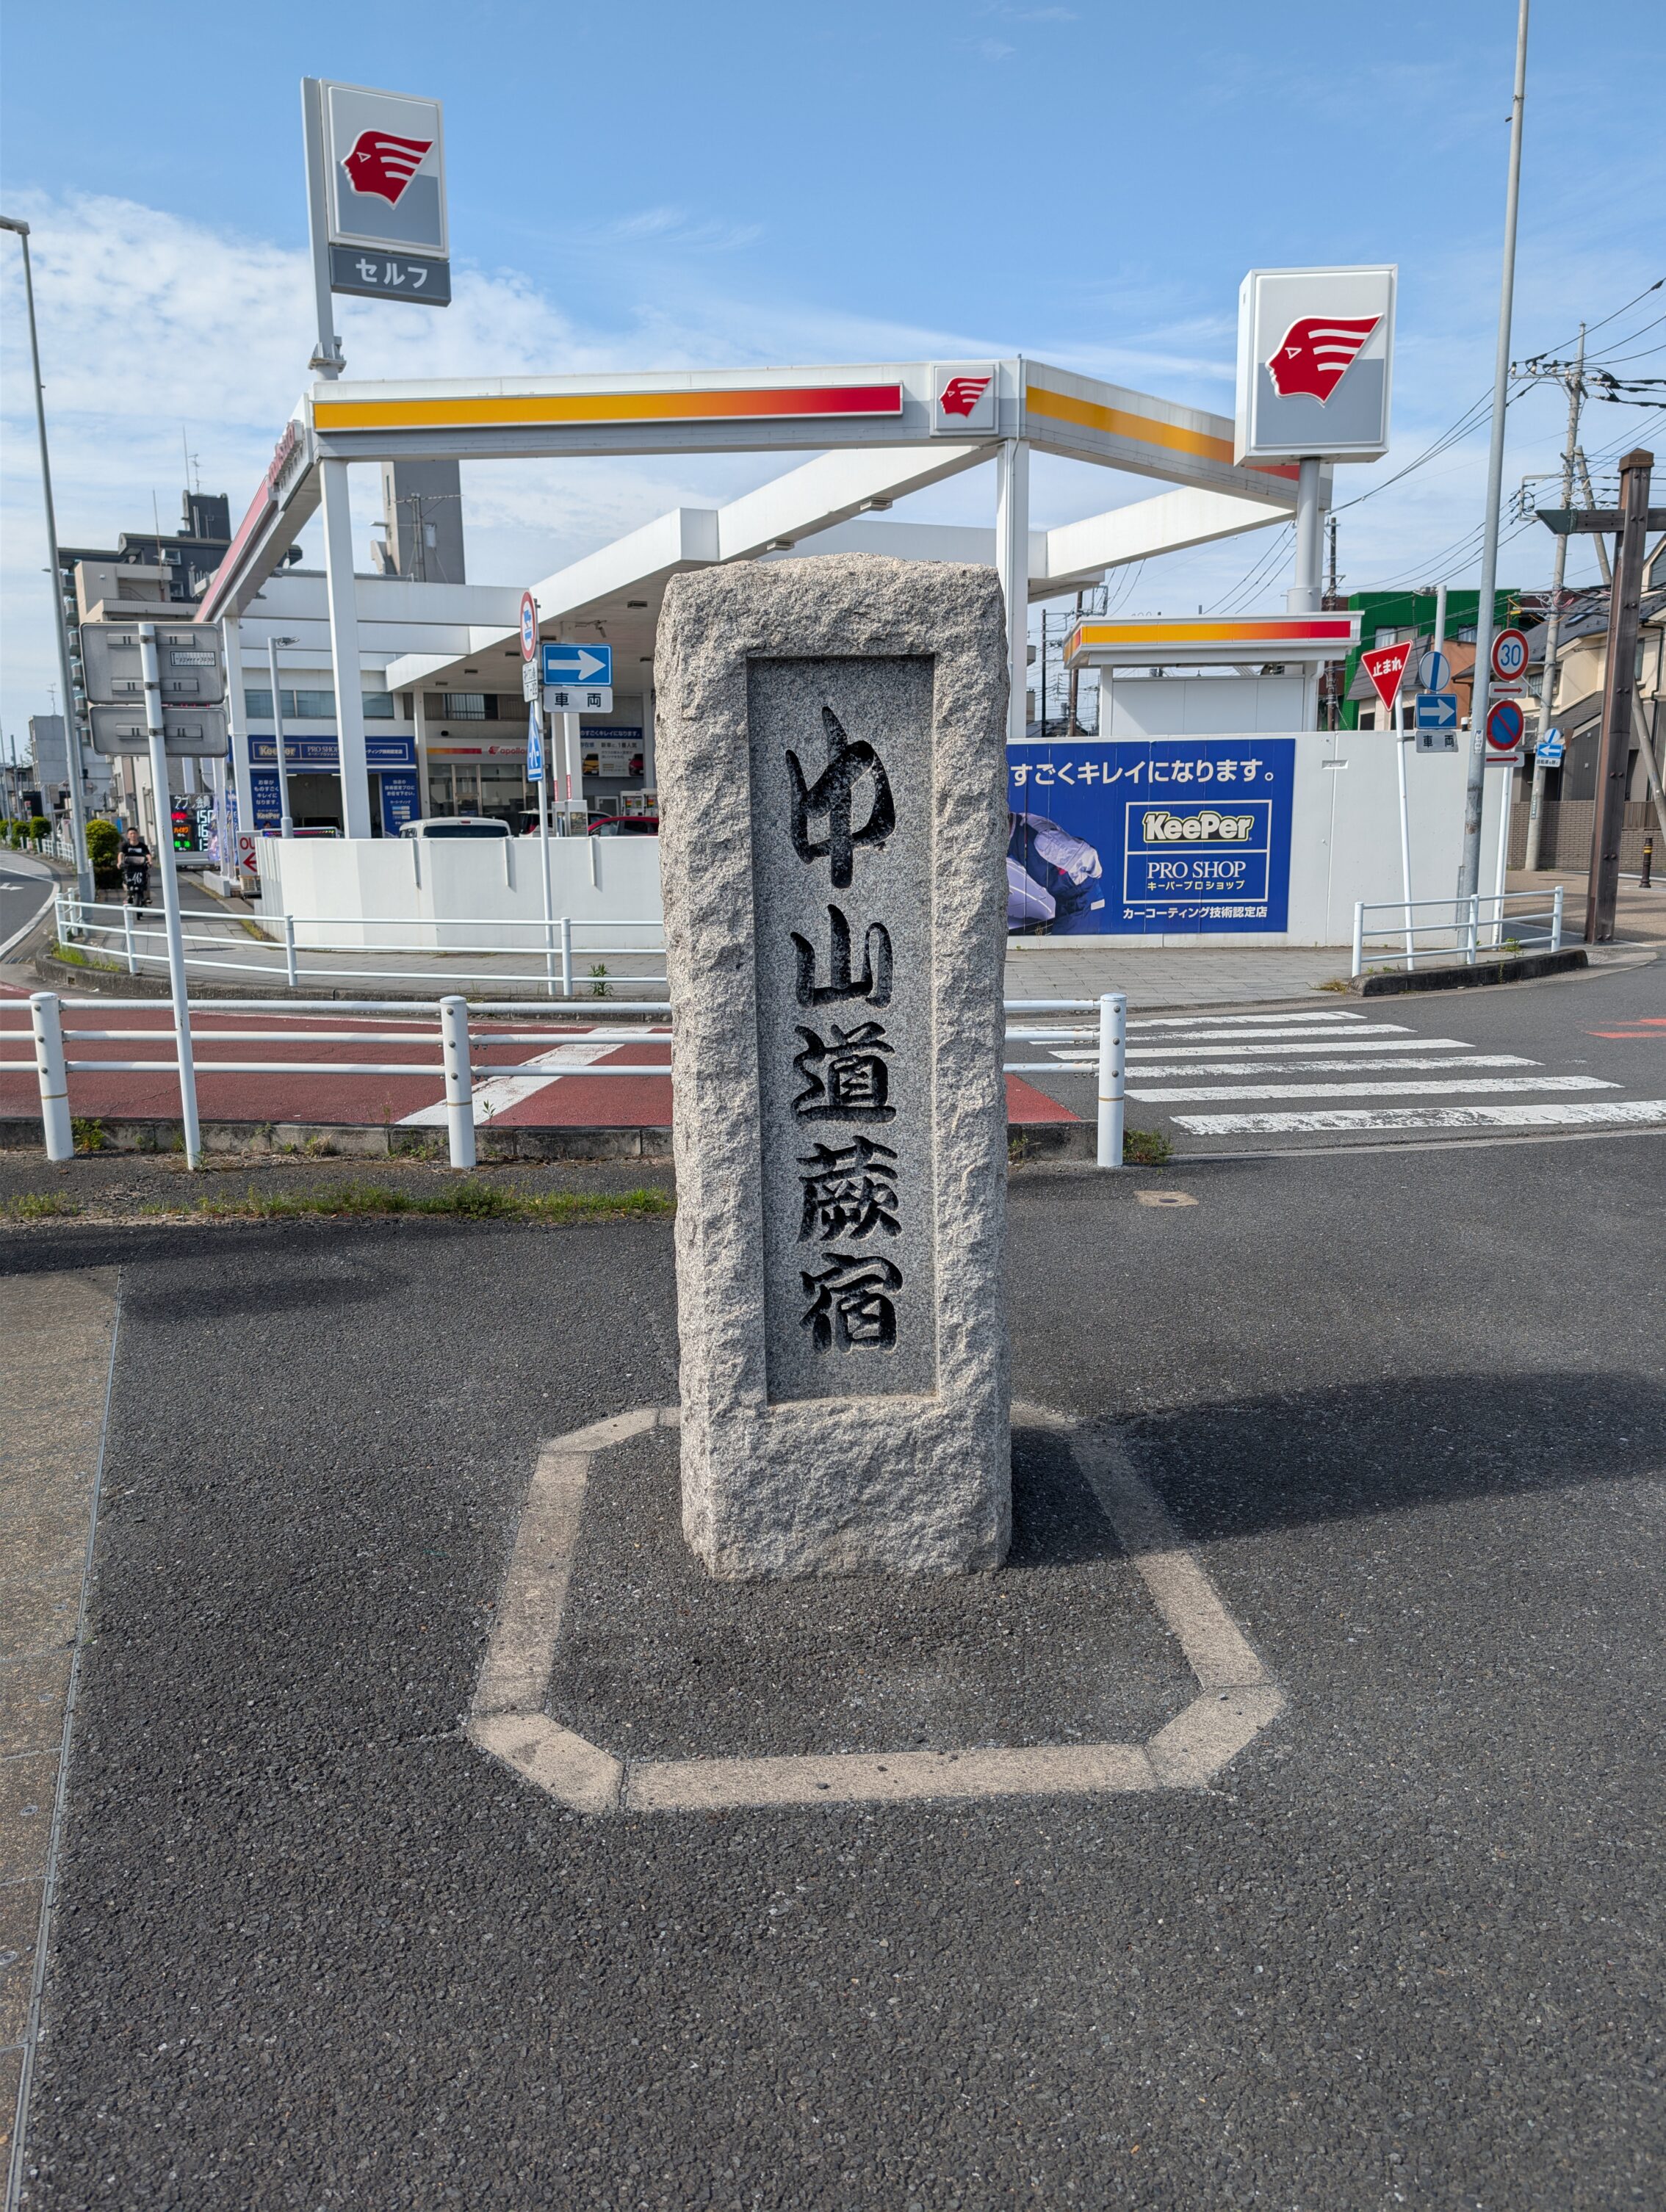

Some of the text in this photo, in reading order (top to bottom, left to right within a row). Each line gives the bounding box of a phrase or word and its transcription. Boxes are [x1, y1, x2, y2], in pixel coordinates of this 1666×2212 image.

[356, 258, 428, 289] セルフ
[1500, 644, 1521, 667] 30
[1372, 657, 1403, 677] 止まれ
[554, 692, 602, 708] 車両
[259, 745, 295, 756] Keeer
[1422, 734, 1454, 748] 車両
[1010, 759, 1274, 787] すごくキレイになります。
[1143, 812, 1254, 842] KeePer
[1147, 861, 1247, 879] PRO SHOP
[1147, 880, 1246, 891] キーパープロショップ
[1122, 906, 1268, 919] カーコーティング技術認定店
[785, 706, 904, 1356] 中山道蕨宿
